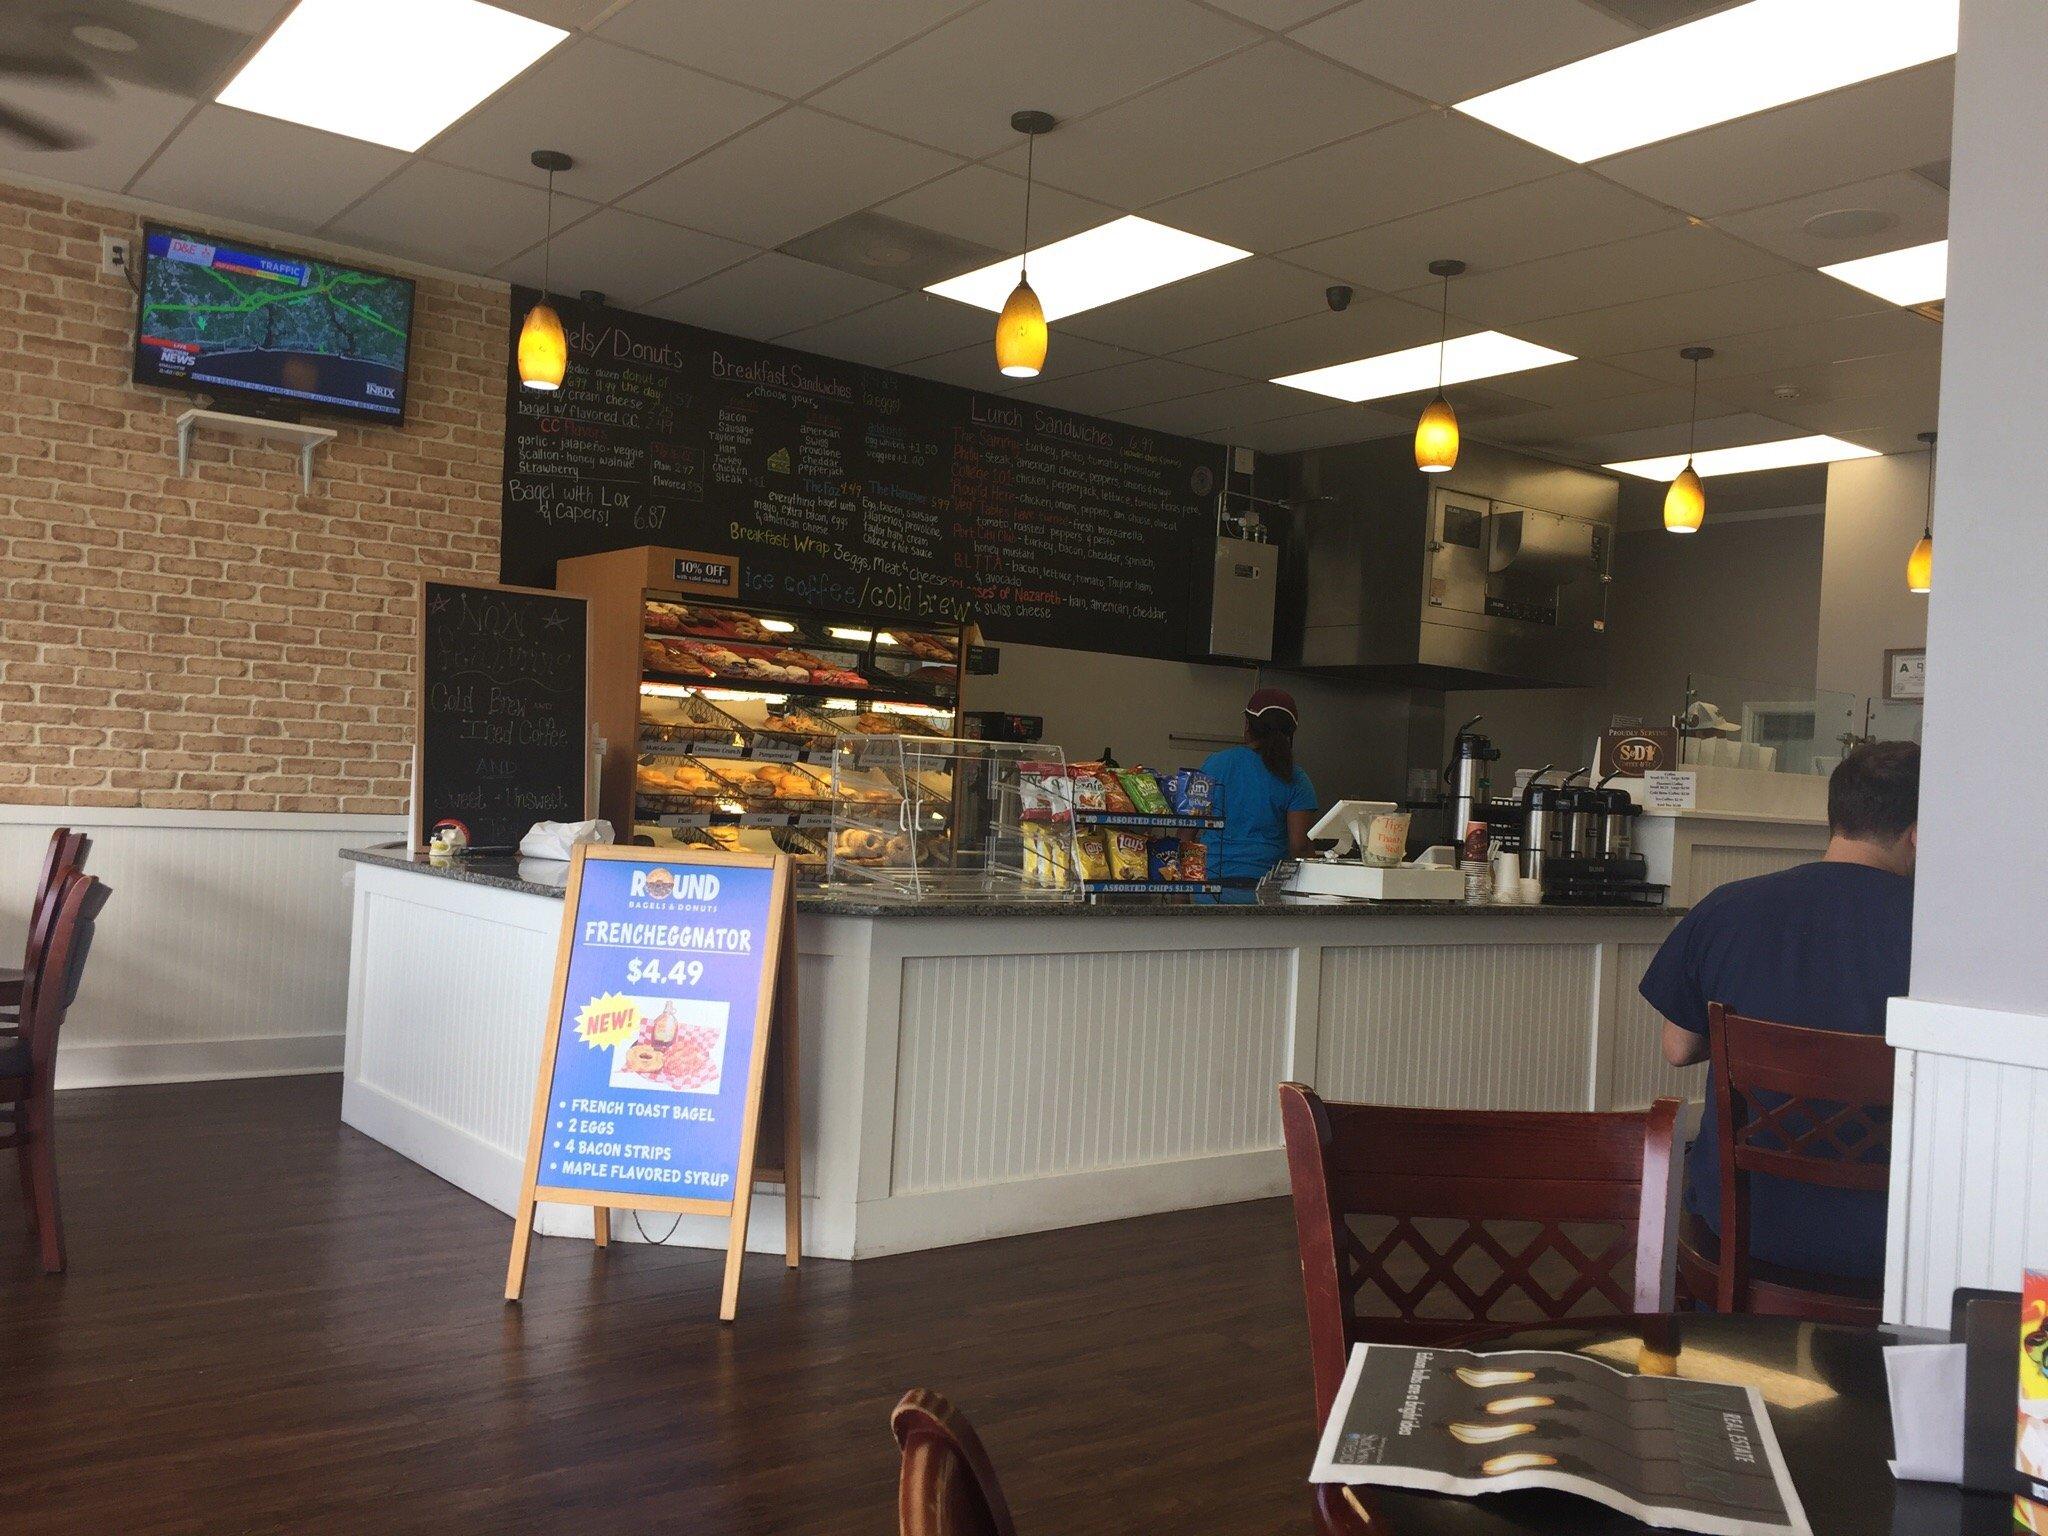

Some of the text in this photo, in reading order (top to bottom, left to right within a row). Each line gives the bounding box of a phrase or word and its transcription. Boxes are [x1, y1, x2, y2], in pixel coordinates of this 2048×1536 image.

[260, 259, 301, 277] TRAFFIC
[161, 352, 196, 366] NEWS
[712, 350, 790, 387] Breakfast
[366, 382, 395, 400] INRIX
[518, 400, 550, 418] bagel
[718, 409, 747, 423] Bacon
[718, 421, 755, 437] Sausage
[971, 395, 1114, 448] Lunch Sandwiches
[517, 435, 549, 450] garlic
[508, 479, 631, 513] Bagel with Lox
[768, 490, 816, 509] everything
[555, 502, 611, 528] Capers!
[729, 520, 790, 549] Breakfast
[792, 534, 831, 559] Wrap
[1013, 522, 1046, 535] roasted
[1049, 528, 1083, 543] peppers
[974, 540, 1035, 560] honey mustard
[680, 561, 726, 577] 10% OFF
[985, 571, 1022, 588] avocado
[917, 584, 970, 622] brew
[1013, 587, 1062, 606] Nazareth
[983, 602, 1012, 618] swiss
[1105, 816, 1150, 824] ASSORTED
[1151, 818, 1177, 826] CHIPS
[629, 868, 720, 902] ROUND
[1102, 884, 1148, 892] ASSORTED
[1149, 885, 1174, 893] CHIPS
[628, 900, 666, 911] BAGELS
[677, 903, 718, 913] DONUTS
[584, 920, 752, 952] FRENCHEGGNATOR
[626, 956, 704, 987] $4.49
[586, 1008, 635, 1036] NEW!
[571, 1098, 716, 1122] FRENCH TOAST BAGEL
[568, 1118, 615, 1135] 2 EGGS
[565, 1139, 672, 1161] 4 BACON STRIPS
[562, 1160, 729, 1188] MAPLE FLAVORED SYRUP
